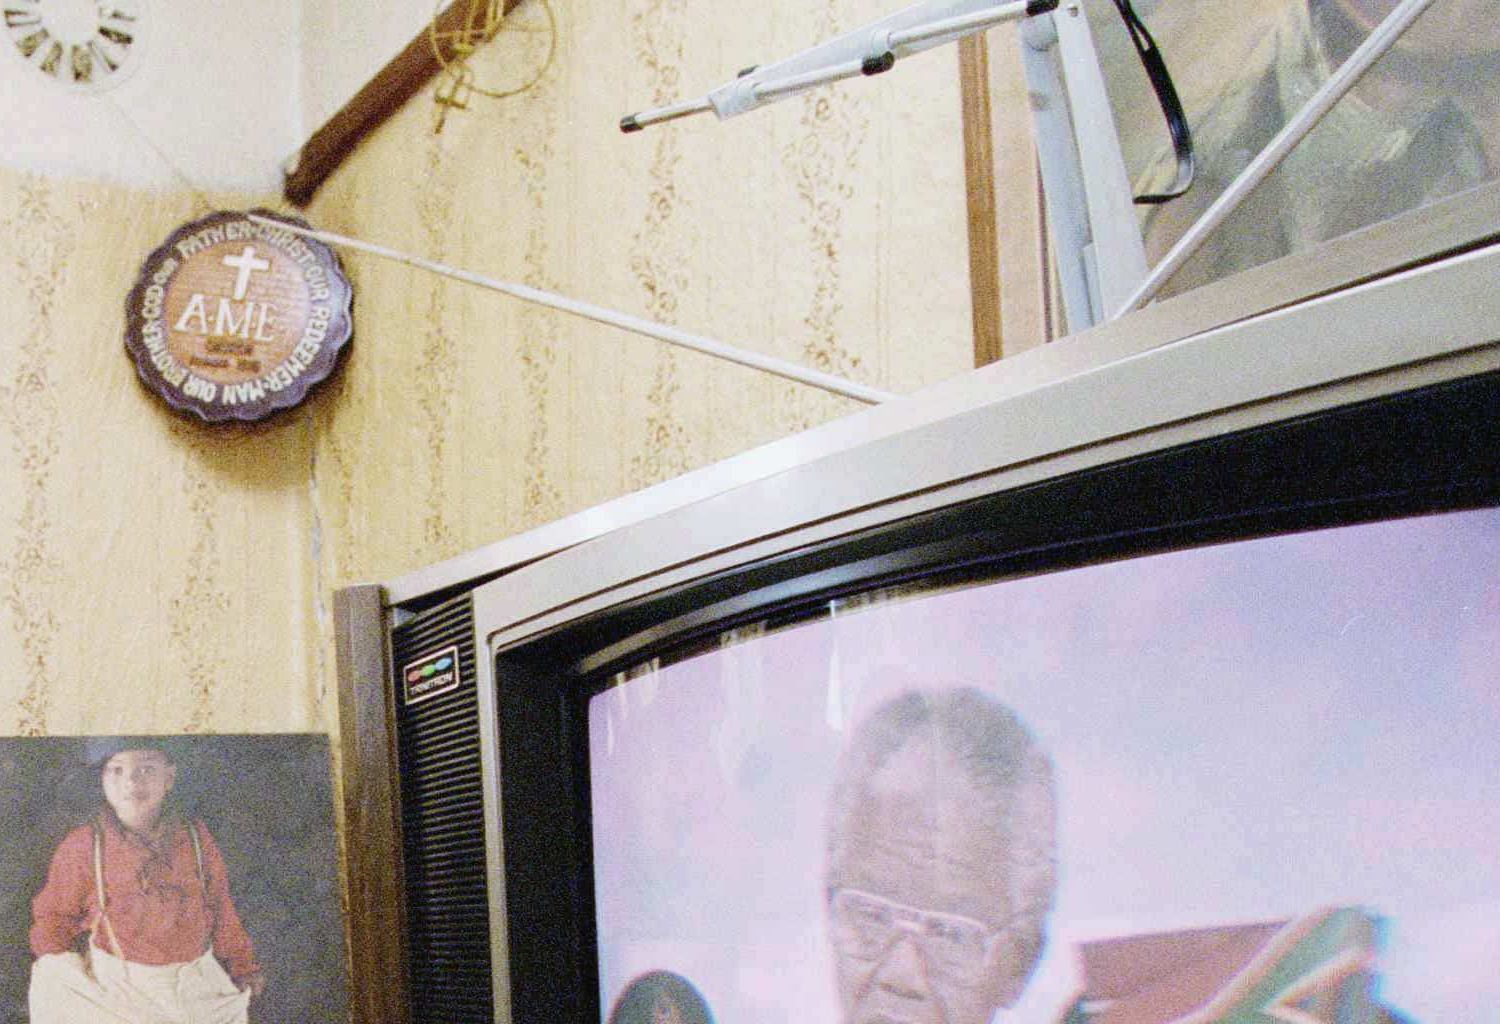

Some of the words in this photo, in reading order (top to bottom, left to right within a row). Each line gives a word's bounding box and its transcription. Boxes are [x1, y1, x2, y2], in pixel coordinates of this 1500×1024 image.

[307, 264, 330, 301] OUR
[183, 374, 217, 403] OUR
[221, 380, 266, 405] MAN
